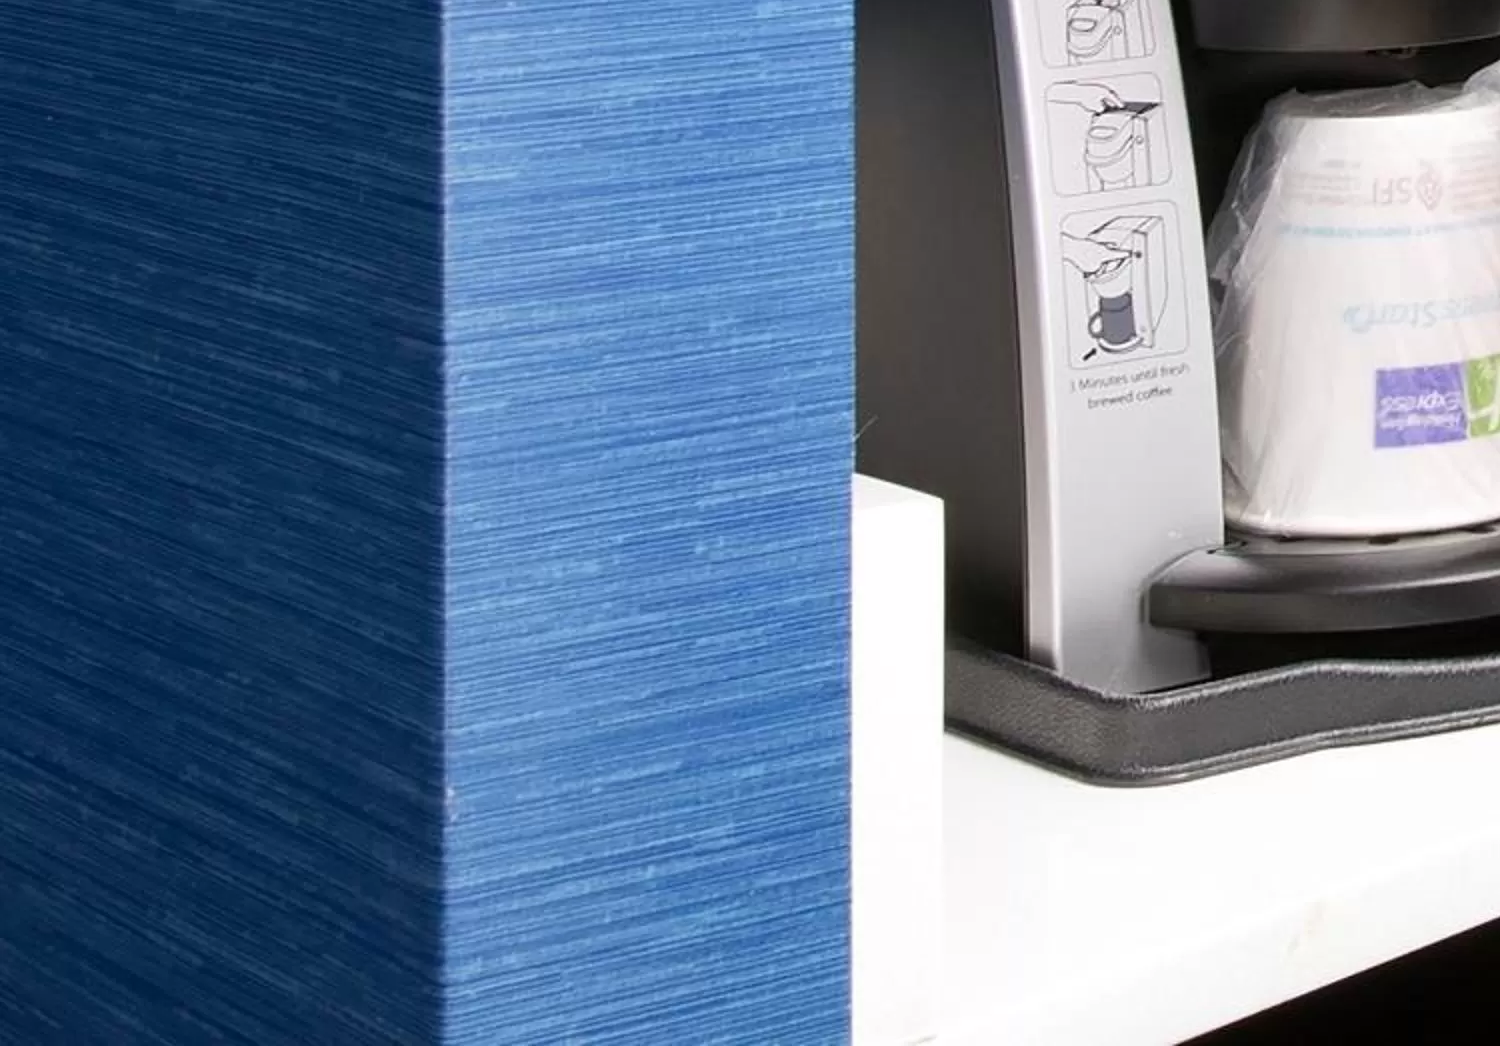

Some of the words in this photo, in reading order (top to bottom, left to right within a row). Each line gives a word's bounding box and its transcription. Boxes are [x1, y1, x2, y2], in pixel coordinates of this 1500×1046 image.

[1371, 177, 1414, 204] SFI
[1078, 374, 1128, 390] Minutes
[1130, 367, 1158, 383] until
[1160, 362, 1191, 378] fresh
[1087, 390, 1134, 409] brewed
[1136, 386, 1173, 401] coffee
[1379, 390, 1462, 414] Express
